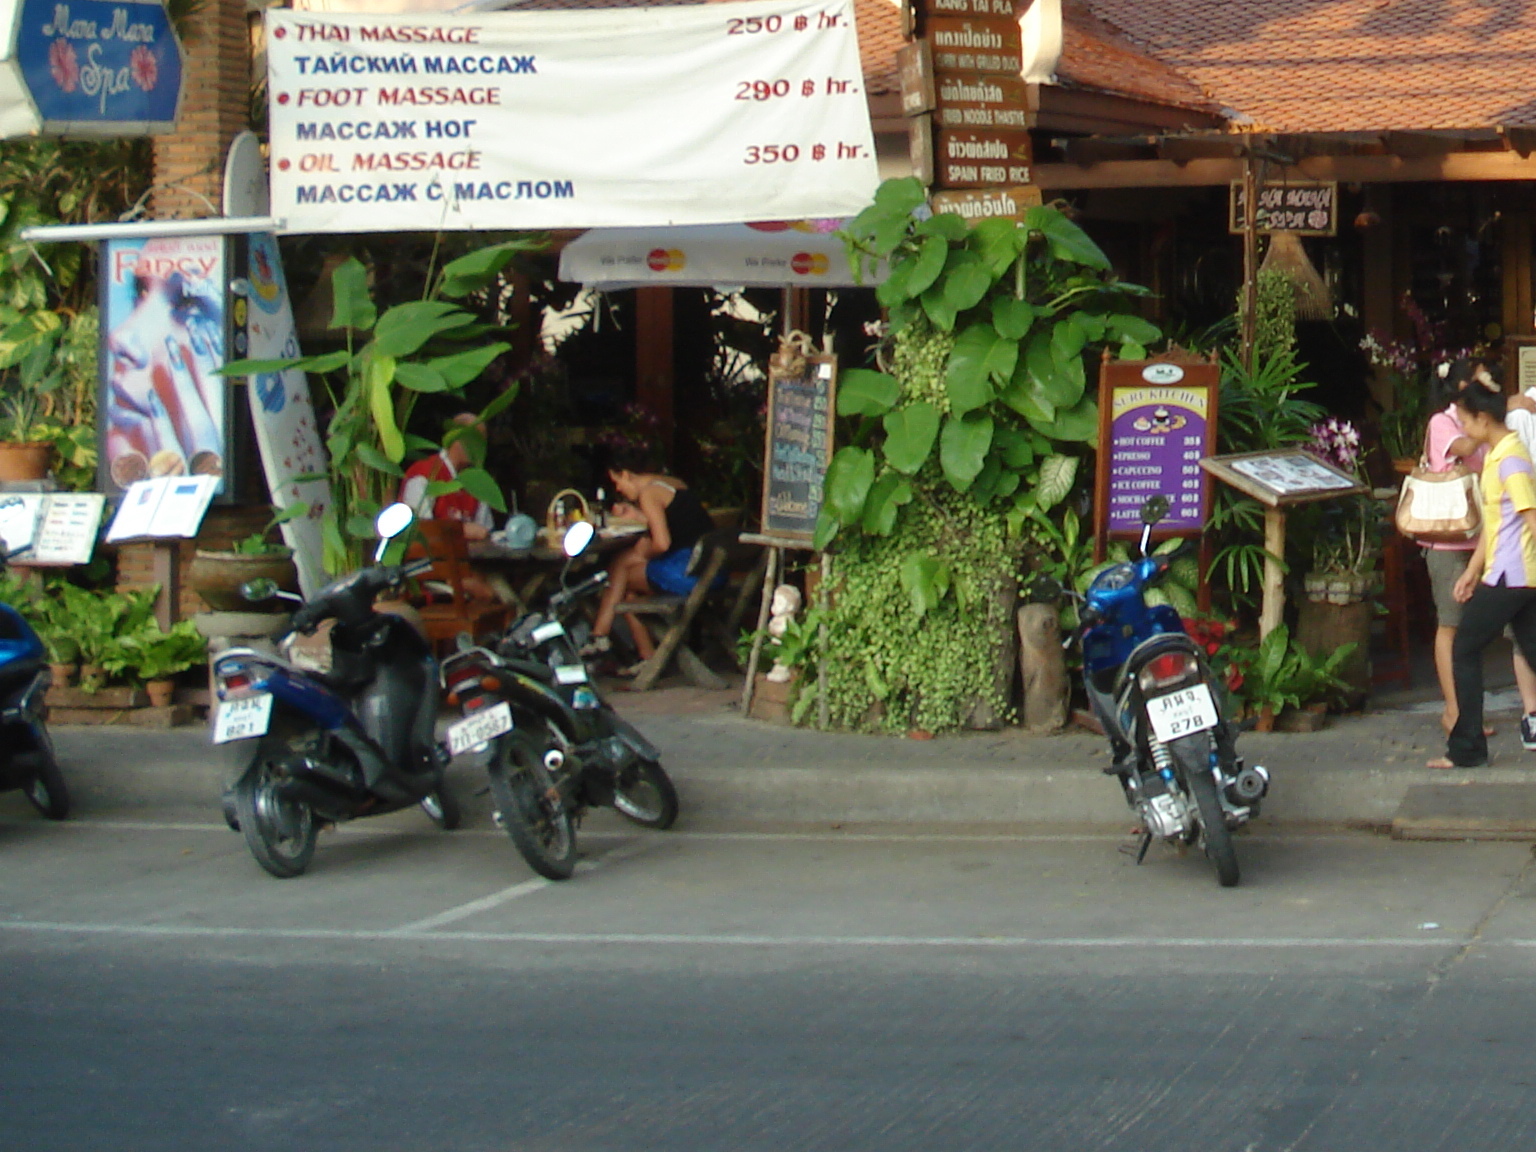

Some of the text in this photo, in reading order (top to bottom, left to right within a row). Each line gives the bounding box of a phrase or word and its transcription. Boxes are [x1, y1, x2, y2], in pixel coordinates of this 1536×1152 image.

[993, 0, 1013, 15] PLA
[726, 14, 782, 35] 250
[817, 10, 848, 30] hr.
[296, 24, 482, 44] THAI MASSAGE
[294, 52, 537, 74] ТАЙСКИЙ МАССАЖ
[80, 43, 130, 114] Spa
[734, 78, 791, 102] 290
[826, 76, 858, 96] hr.
[297, 87, 501, 107] FOOT MASSAGE
[296, 120, 477, 141] МАССАЖ НОГ
[299, 151, 482, 173] OIL MASSAGE
[744, 144, 799, 165] 350
[837, 141, 869, 160] hr.
[948, 165, 1030, 183] SPAIN FRIED RICE
[296, 184, 417, 204] МАССАЖ
[454, 181, 574, 201] МАСЛОМ
[115, 251, 218, 283] Fancy
[1170, 715, 1203, 734] 278
